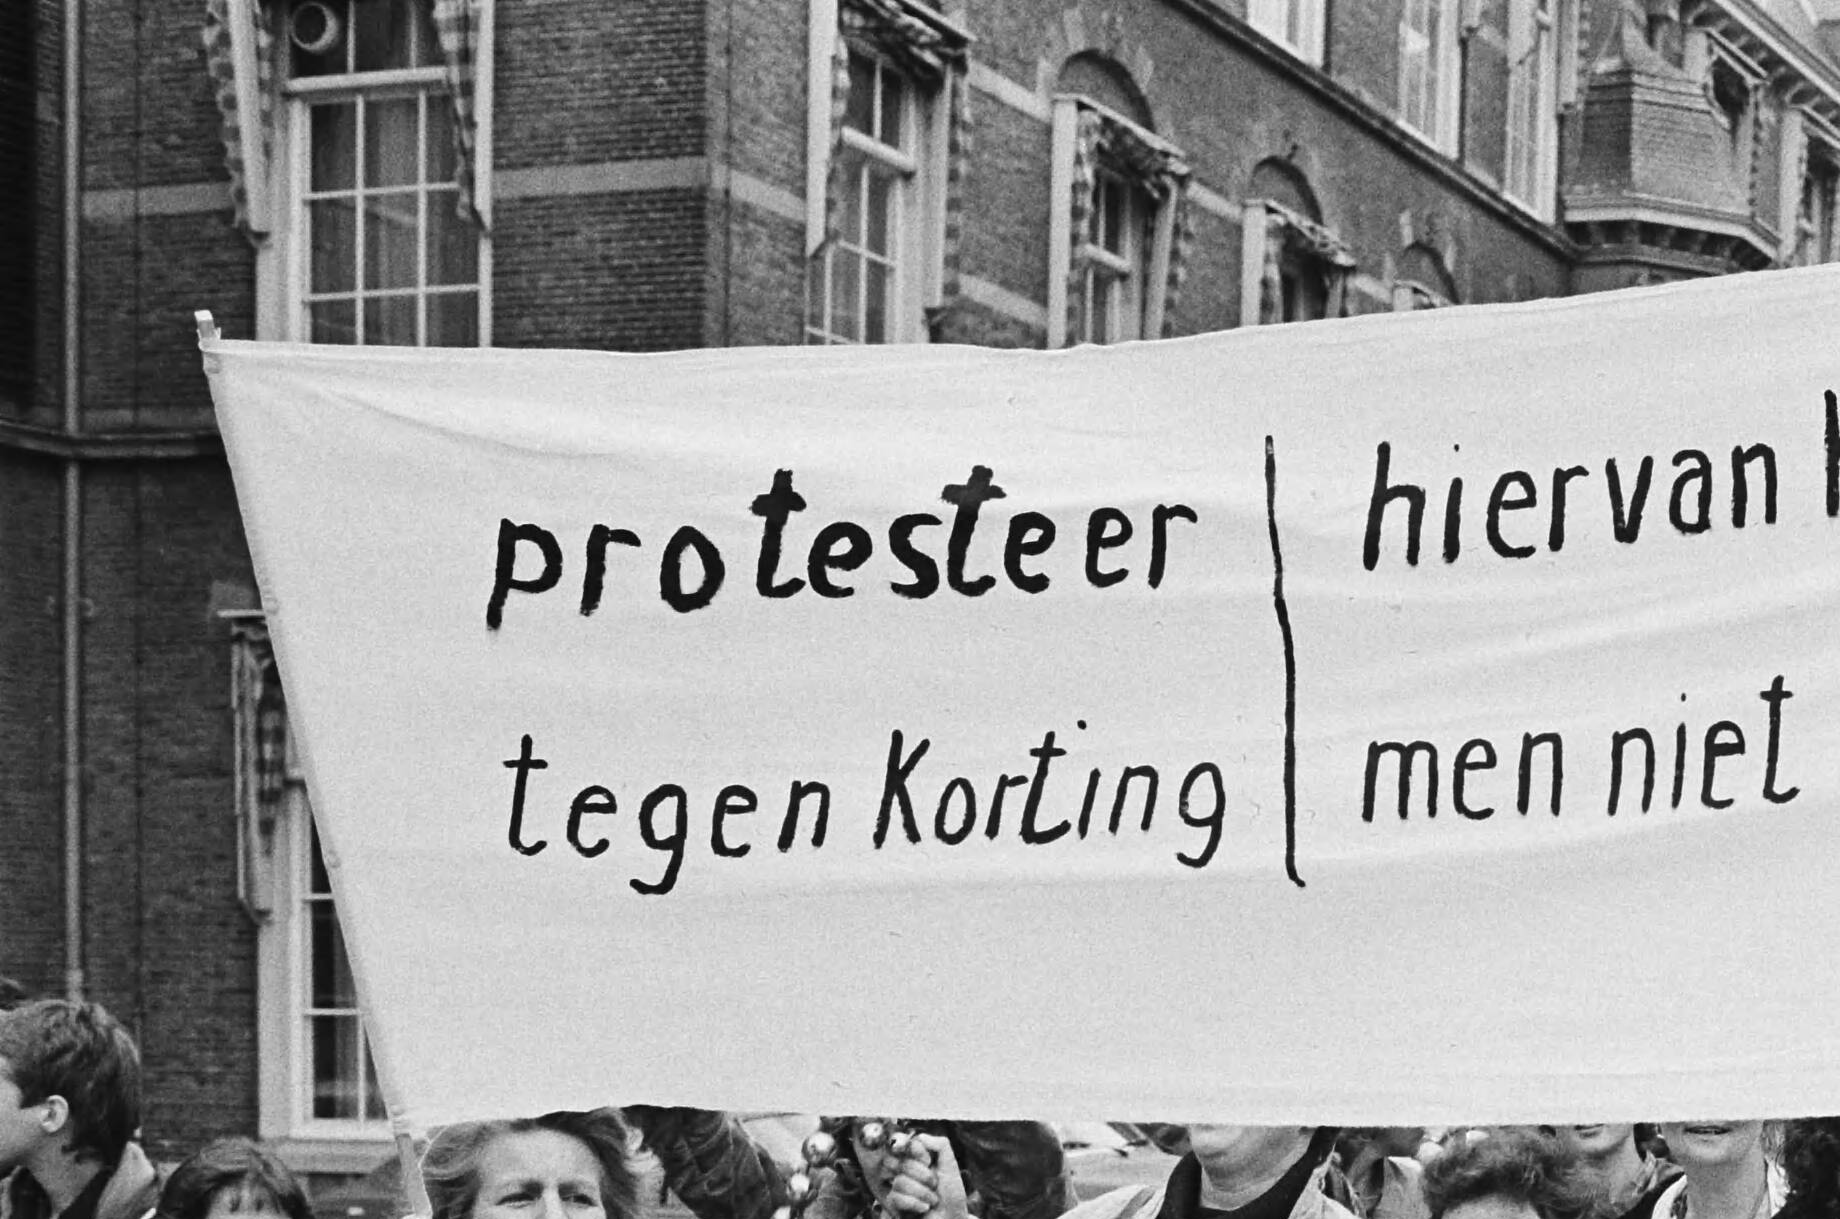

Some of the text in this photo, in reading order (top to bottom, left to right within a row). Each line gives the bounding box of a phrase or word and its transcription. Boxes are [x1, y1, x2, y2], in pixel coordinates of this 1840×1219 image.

[486, 466, 1198, 631] protesteer
[503, 720, 1226, 896] tegen Korting
[1362, 732, 1565, 823] men
[1607, 676, 1800, 816] niet
